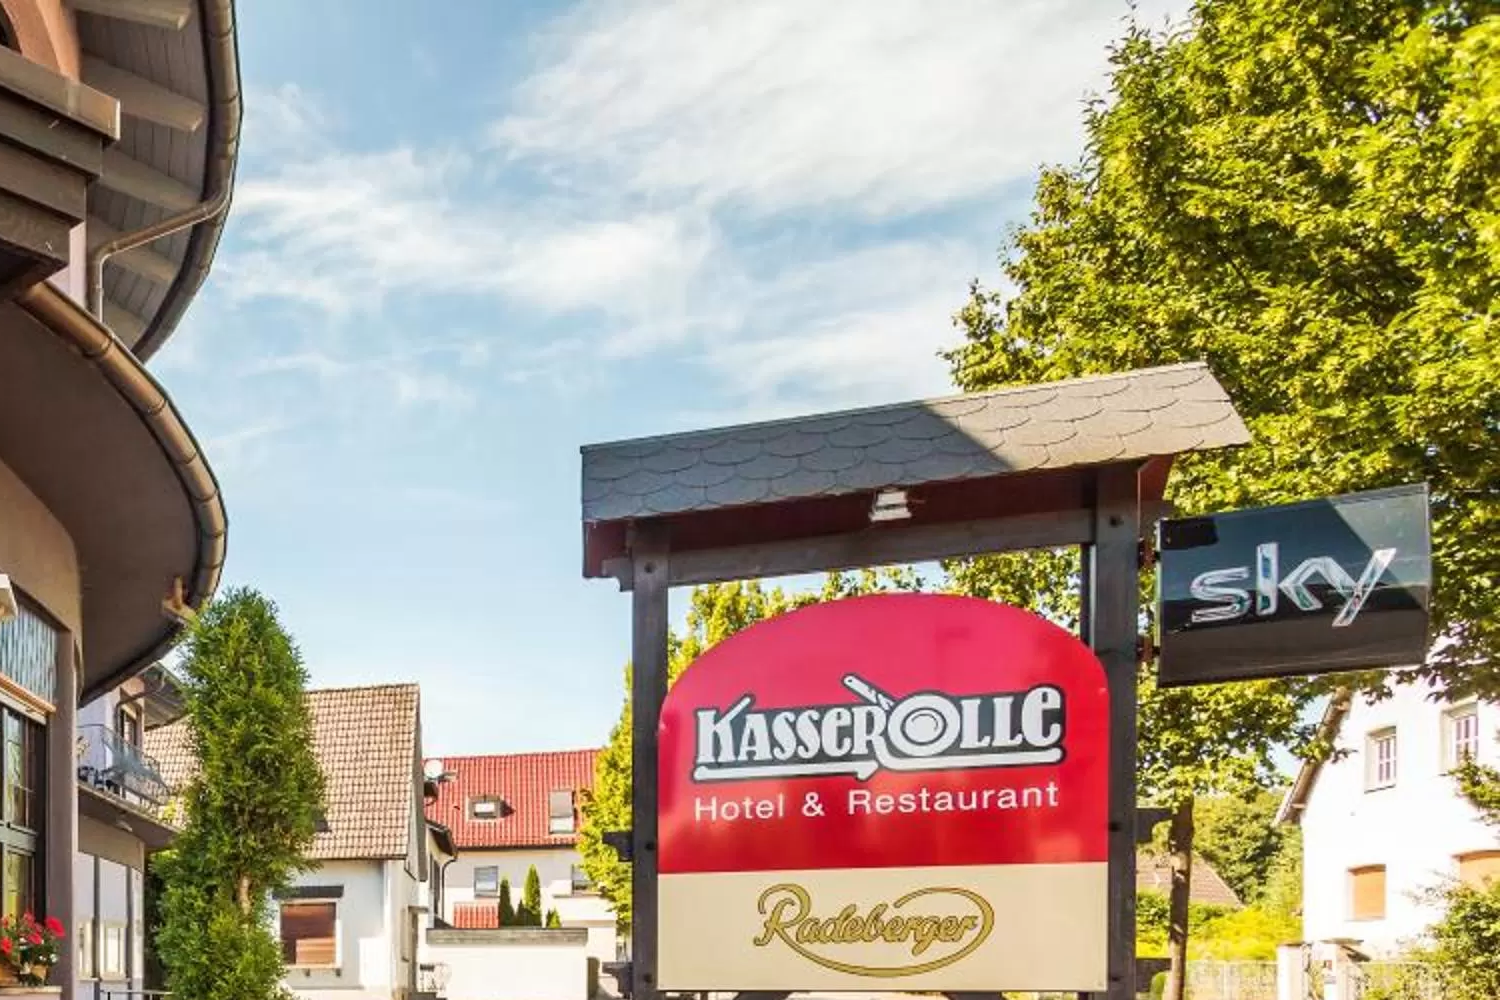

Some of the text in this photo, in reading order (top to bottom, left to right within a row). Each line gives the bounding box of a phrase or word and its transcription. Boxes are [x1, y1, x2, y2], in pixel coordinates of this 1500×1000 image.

[1190, 542, 1396, 627] sky
[694, 781, 1059, 822] Hotel & Restaurant
[754, 883, 984, 960] Radeberger
